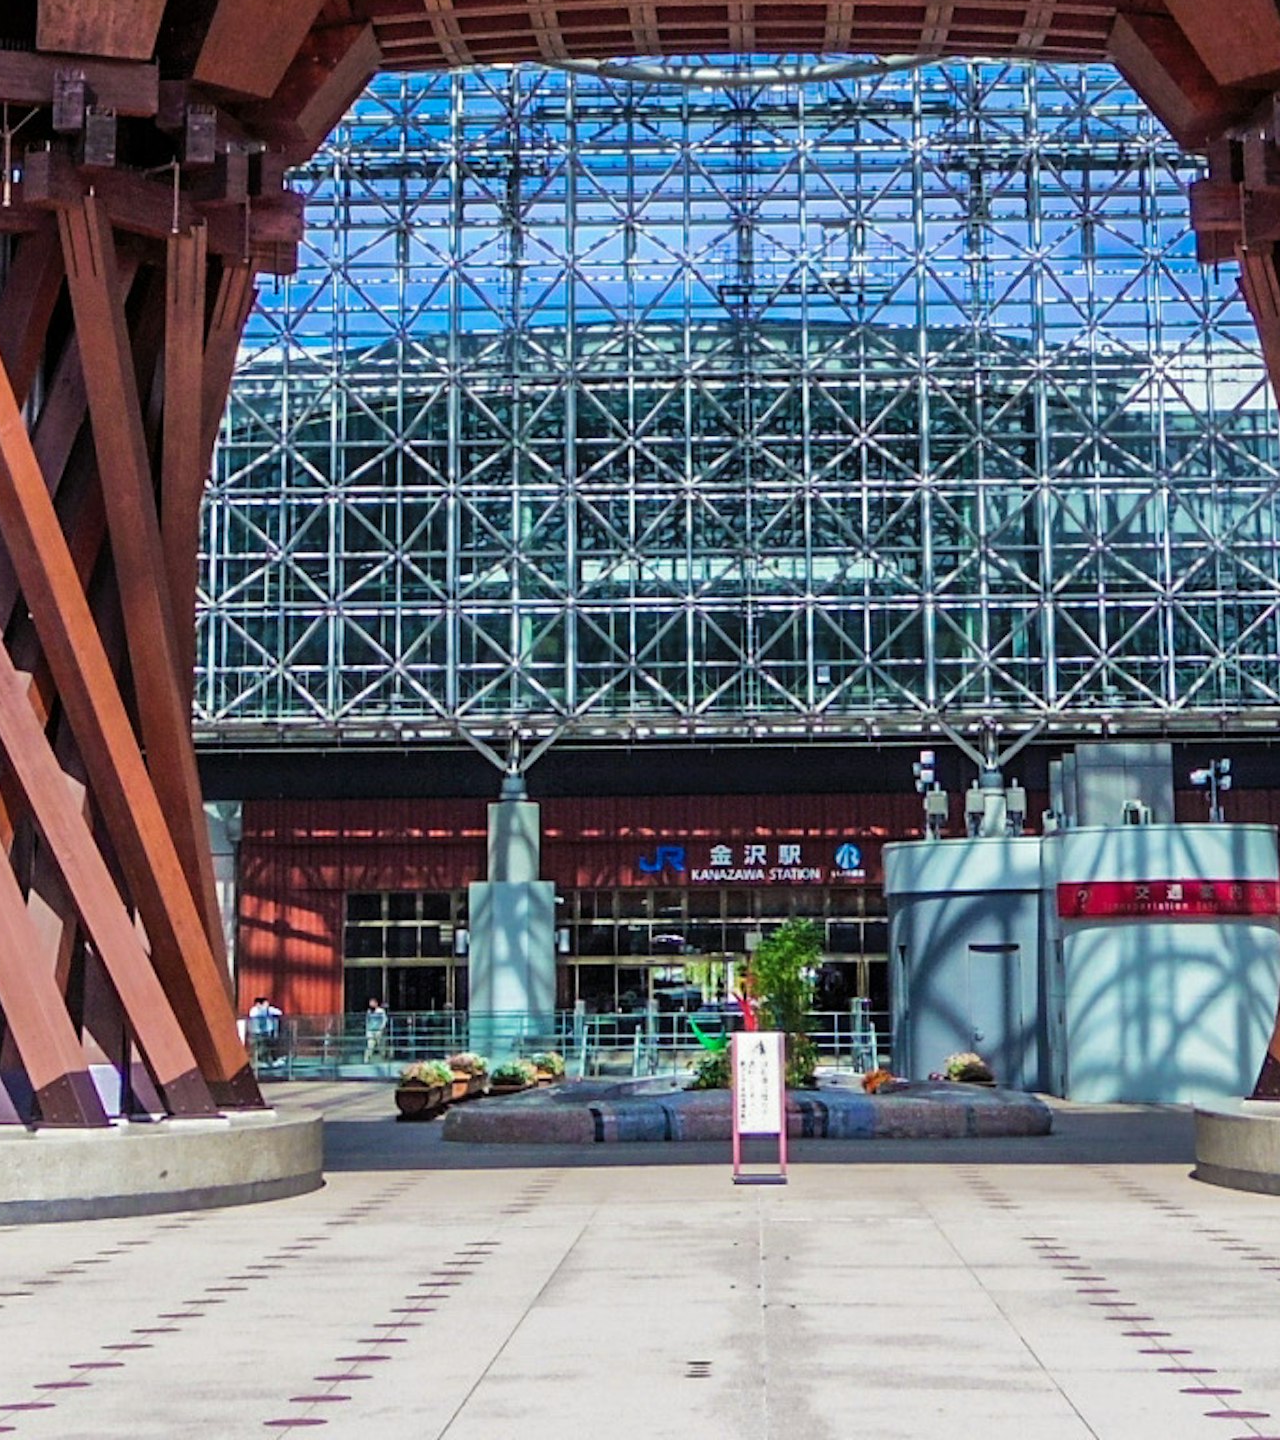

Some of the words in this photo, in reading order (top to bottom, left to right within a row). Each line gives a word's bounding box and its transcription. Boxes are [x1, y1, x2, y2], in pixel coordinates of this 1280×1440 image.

[639, 847, 685, 871] JR
[710, 844, 801, 865] 金沢駅
[691, 868, 765, 880] KANAZAWA
[769, 868, 820, 880] STATION
